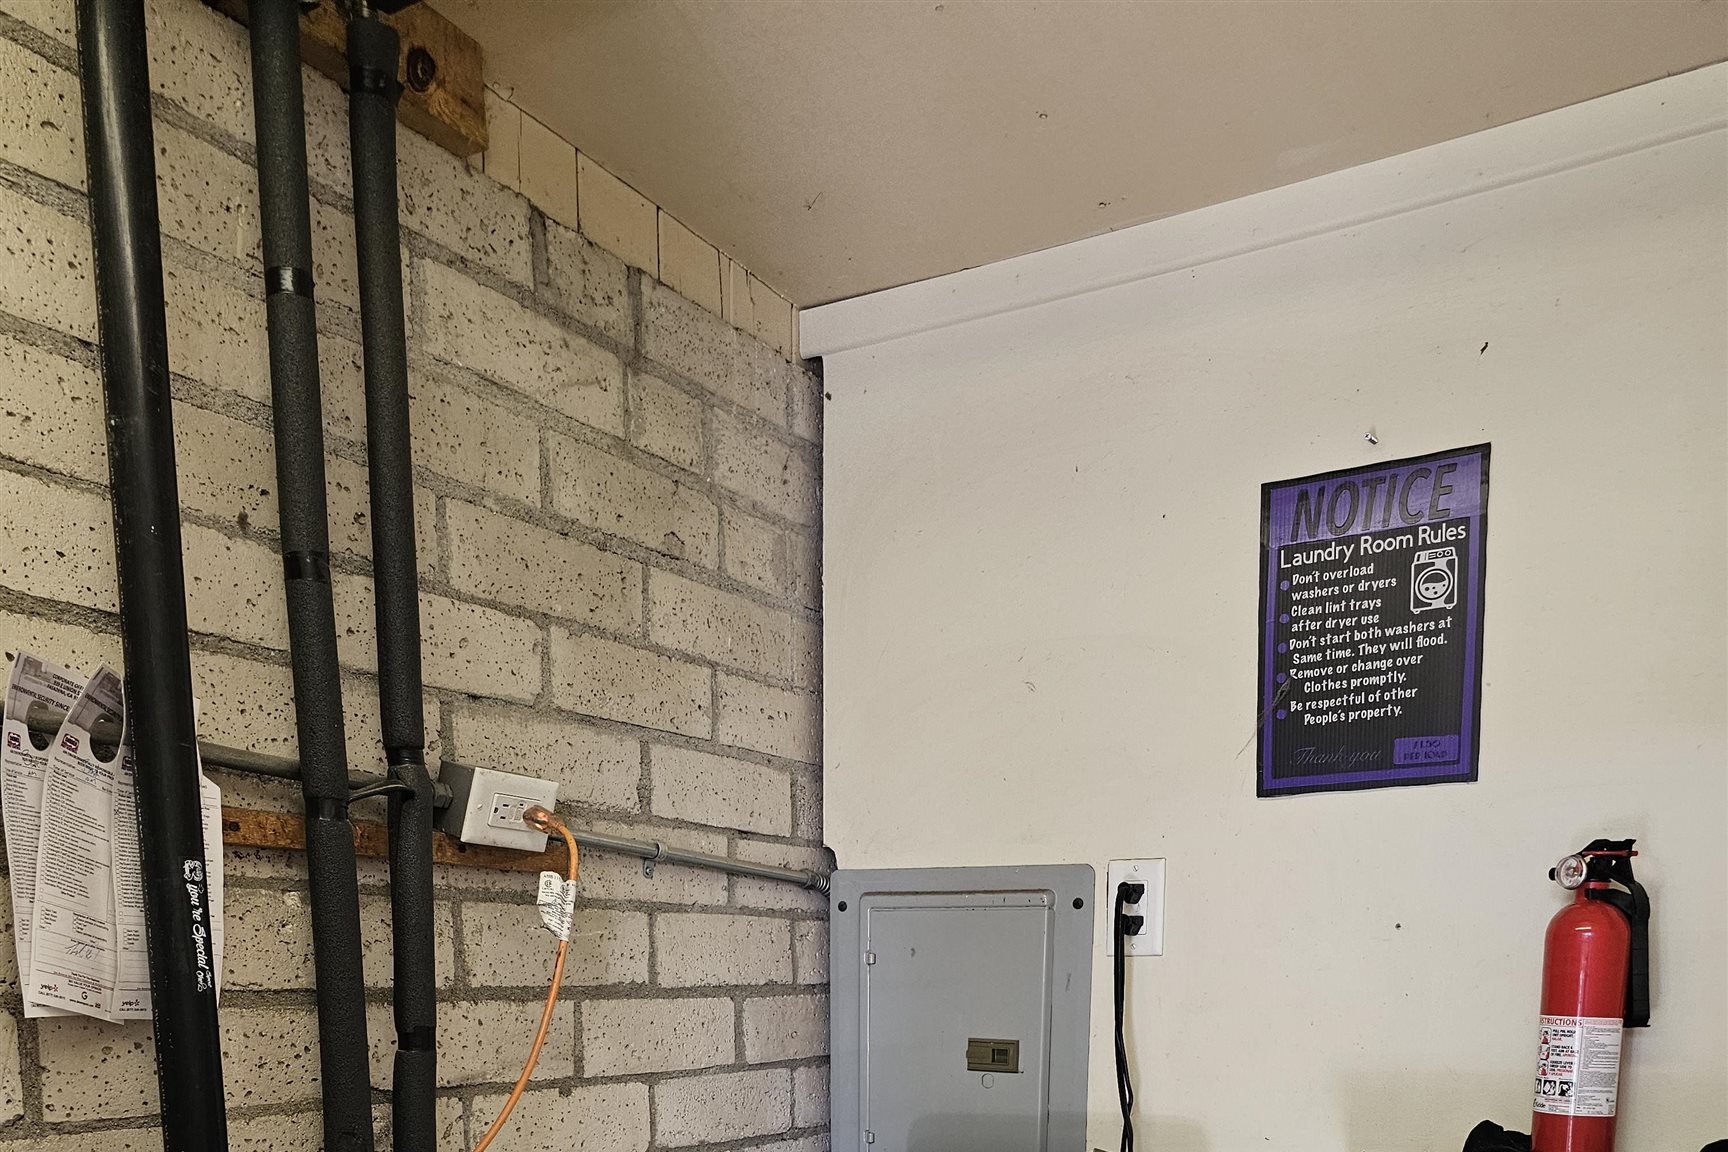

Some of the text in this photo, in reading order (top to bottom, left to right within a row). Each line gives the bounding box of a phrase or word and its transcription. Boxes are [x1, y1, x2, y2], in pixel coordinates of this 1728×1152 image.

[1290, 463, 1458, 542] NOTICE
[1280, 523, 1466, 568] Laundry Room Rules
[1292, 563, 1374, 586] Don't overload
[1291, 578, 1397, 600] washers or dryers
[1291, 598, 1382, 617] Clean lint trays
[1289, 616, 1452, 650] Don't start both washers at
[1291, 614, 1380, 632] after dryer use
[1292, 632, 1448, 664] Same time. They will flood.
[1289, 654, 1424, 680] Remove or change over
[1304, 670, 1407, 693] Clothes promptly.
[55, 701, 70, 712] SINCE
[1290, 687, 1418, 712] Be respectful of other
[1304, 704, 1402, 726] People's property.
[1290, 745, 1383, 768] Thank you
[192, 924, 208, 970] Special
[1540, 1018, 1582, 1026] STRUCTIONS
